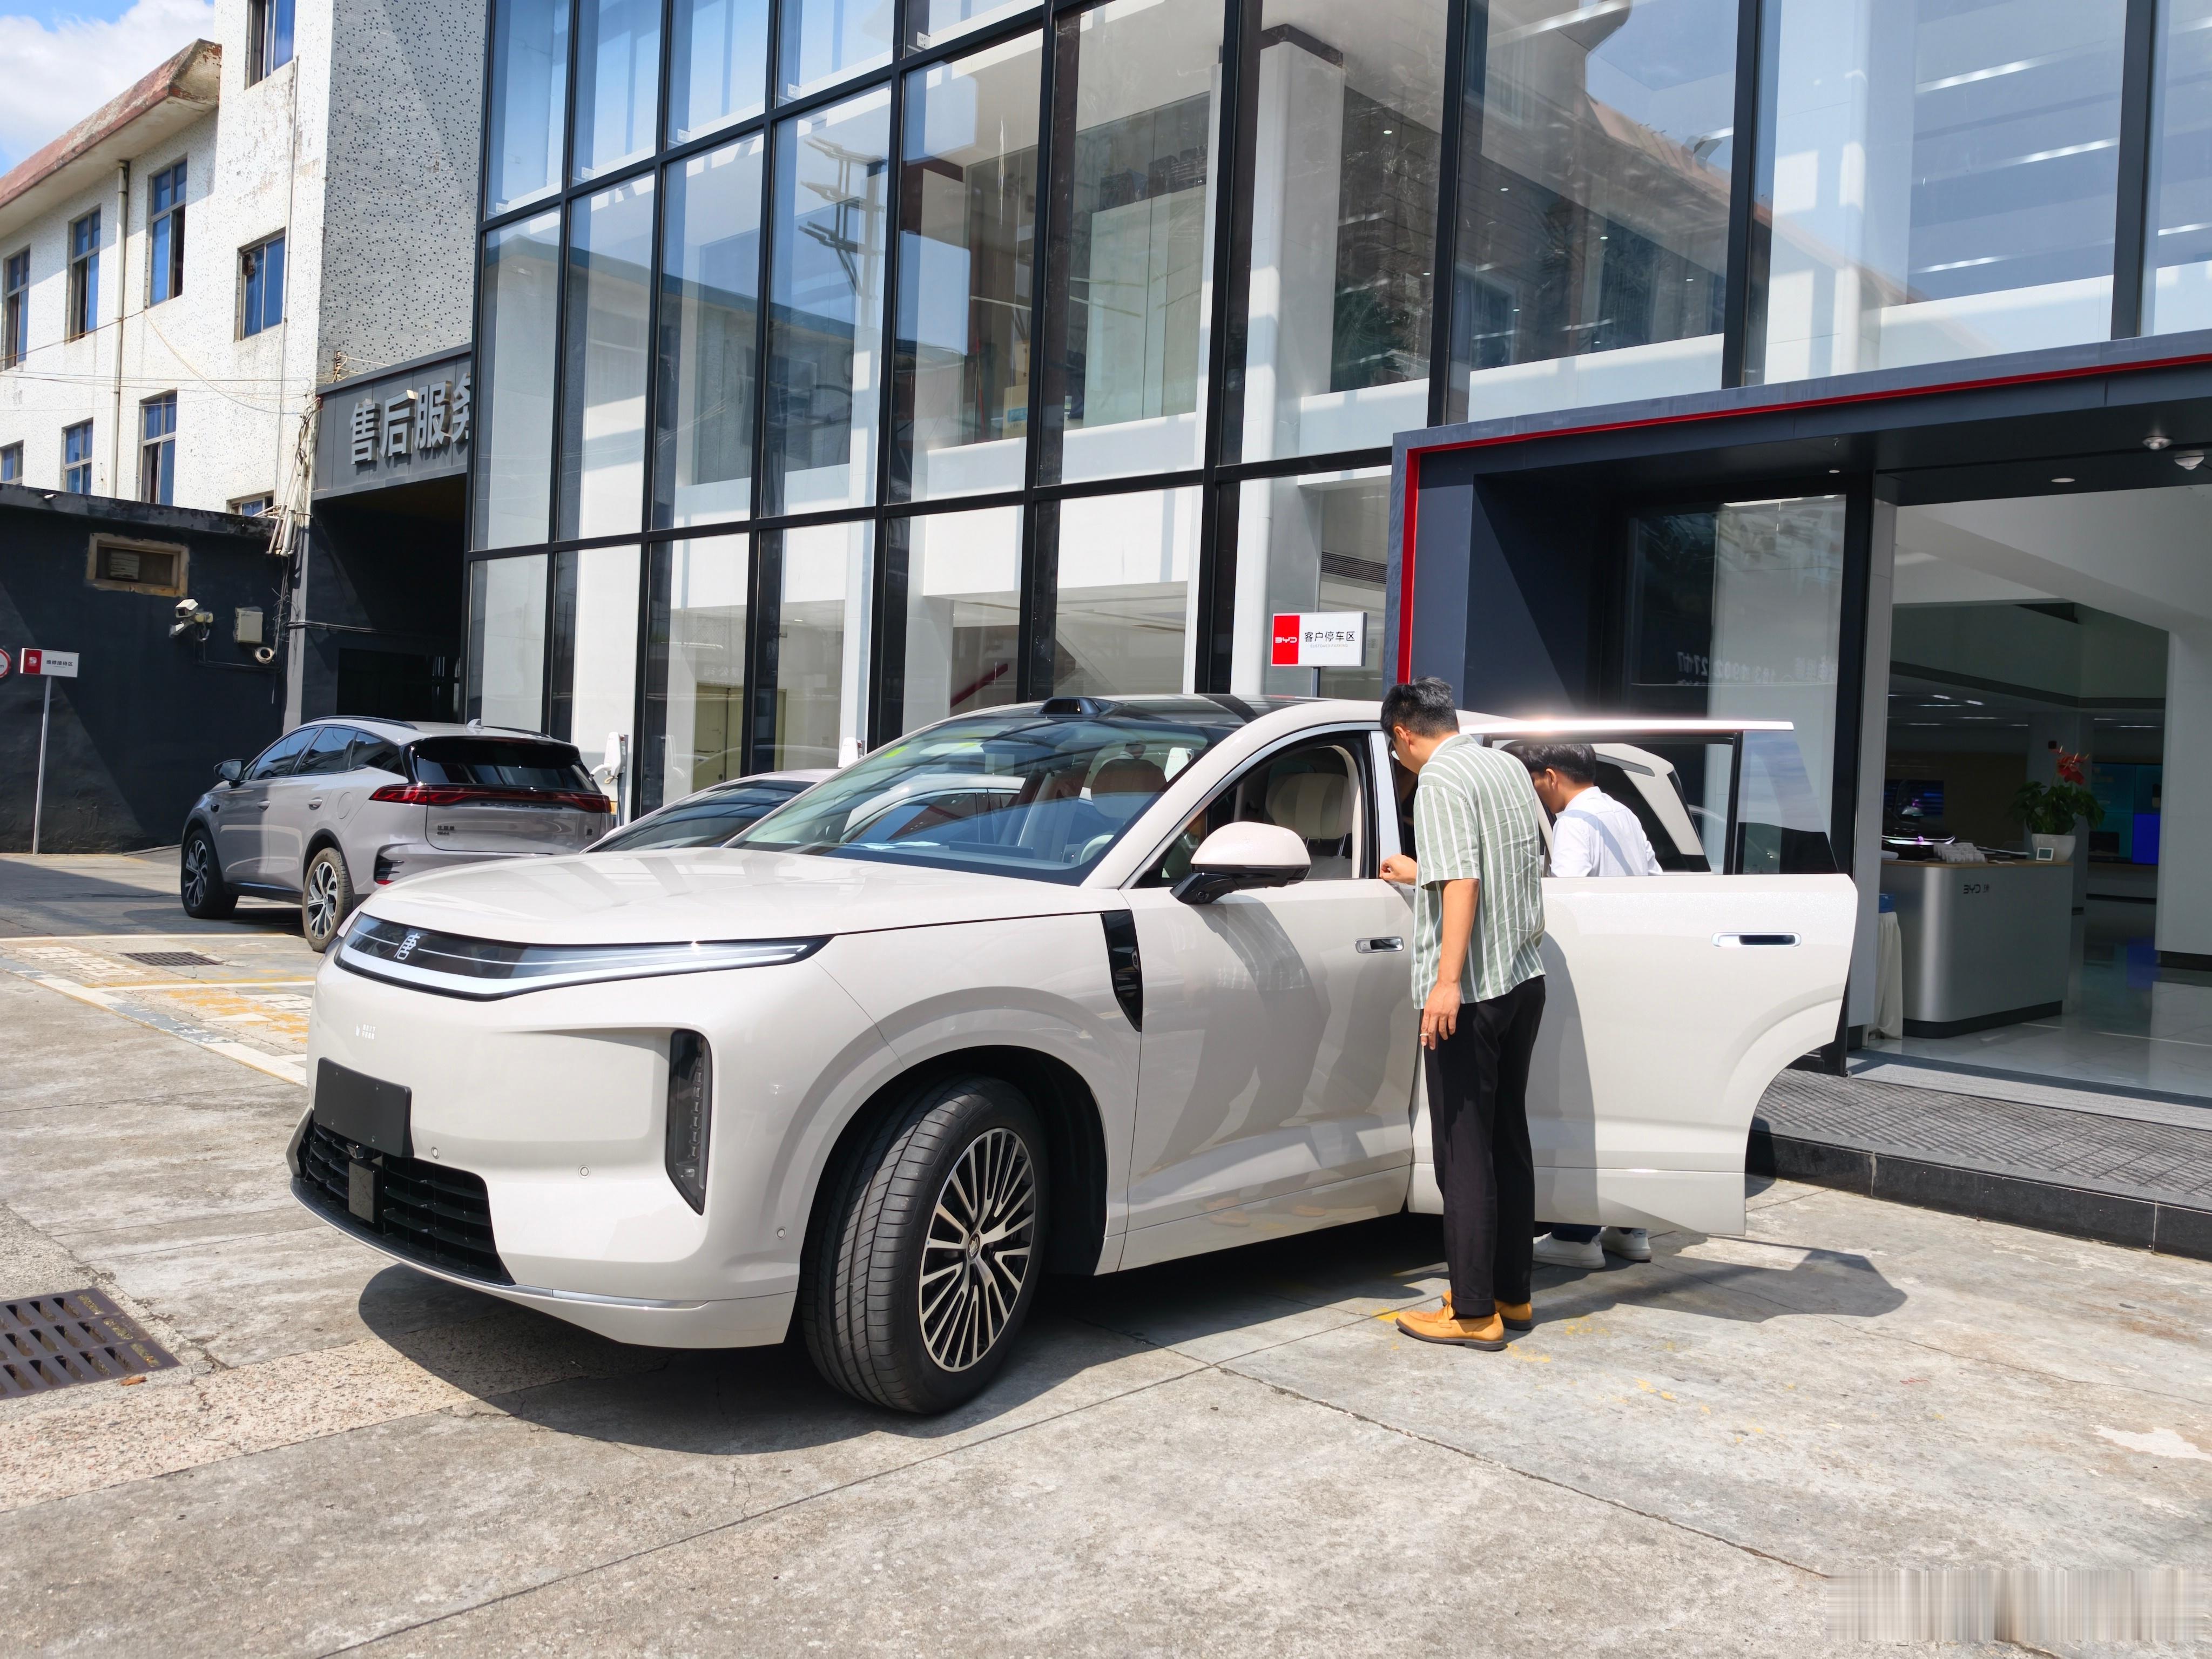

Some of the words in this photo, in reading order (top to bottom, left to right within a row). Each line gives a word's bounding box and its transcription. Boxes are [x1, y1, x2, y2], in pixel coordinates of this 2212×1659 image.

[1304, 631, 1355, 642] 客户停车区
[1963, 884, 1981, 894] BYD
